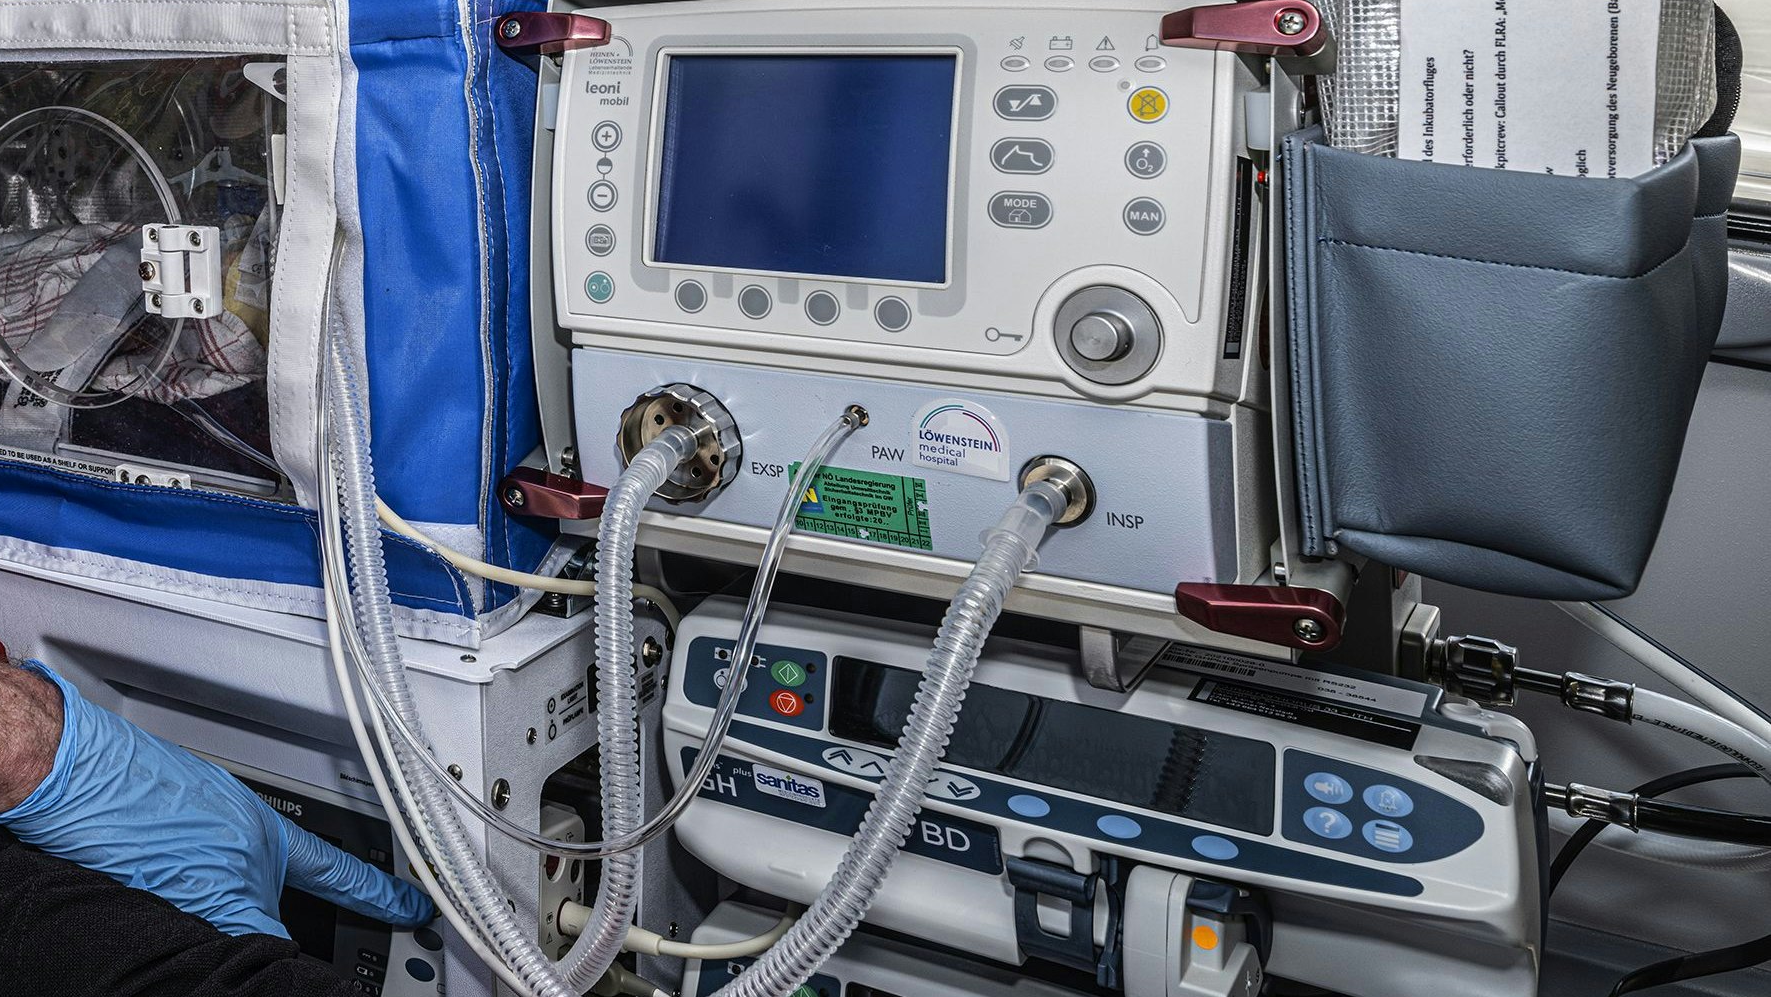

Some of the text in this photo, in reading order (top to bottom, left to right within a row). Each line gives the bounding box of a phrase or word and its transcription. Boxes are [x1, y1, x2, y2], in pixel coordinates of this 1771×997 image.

[1495, 18, 1506, 48] FLRA:
[1607, 17, 1619, 88] Neugeborenen
[1463, 50, 1474, 81] nicht?
[1495, 50, 1506, 80] durch
[586, 81, 621, 94] leoni
[1423, 57, 1437, 136] Inkubatorfluges
[1463, 83, 1474, 107] oder
[600, 97, 629, 106] mobil
[1495, 81, 1506, 118] Callout
[1608, 91, 1618, 111] des
[1423, 143, 1434, 157] des
[1495, 121, 1507, 169] kpitcrew:
[1004, 198, 1037, 209] MODE
[1130, 211, 1159, 222] MAN
[919, 429, 993, 452] LÖWENSTEIN
[8, 450, 16, 458] TO
[16, 451, 25, 460] BE
[26, 453, 42, 463] USED
[42, 456, 52, 464] AS
[58, 459, 77, 469] SHELF
[78, 462, 87, 470] OR
[872, 446, 904, 462] PAW
[919, 442, 966, 459] medical
[919, 453, 959, 467] hospital
[751, 461, 784, 479] EXSP
[835, 475, 896, 490] Landesregierung
[822, 495, 898, 514] Eingangsprüfung
[1107, 511, 1145, 530] INSP
[733, 767, 752, 777] plus
[757, 773, 820, 798] sanitas
[921, 820, 970, 852] BD
